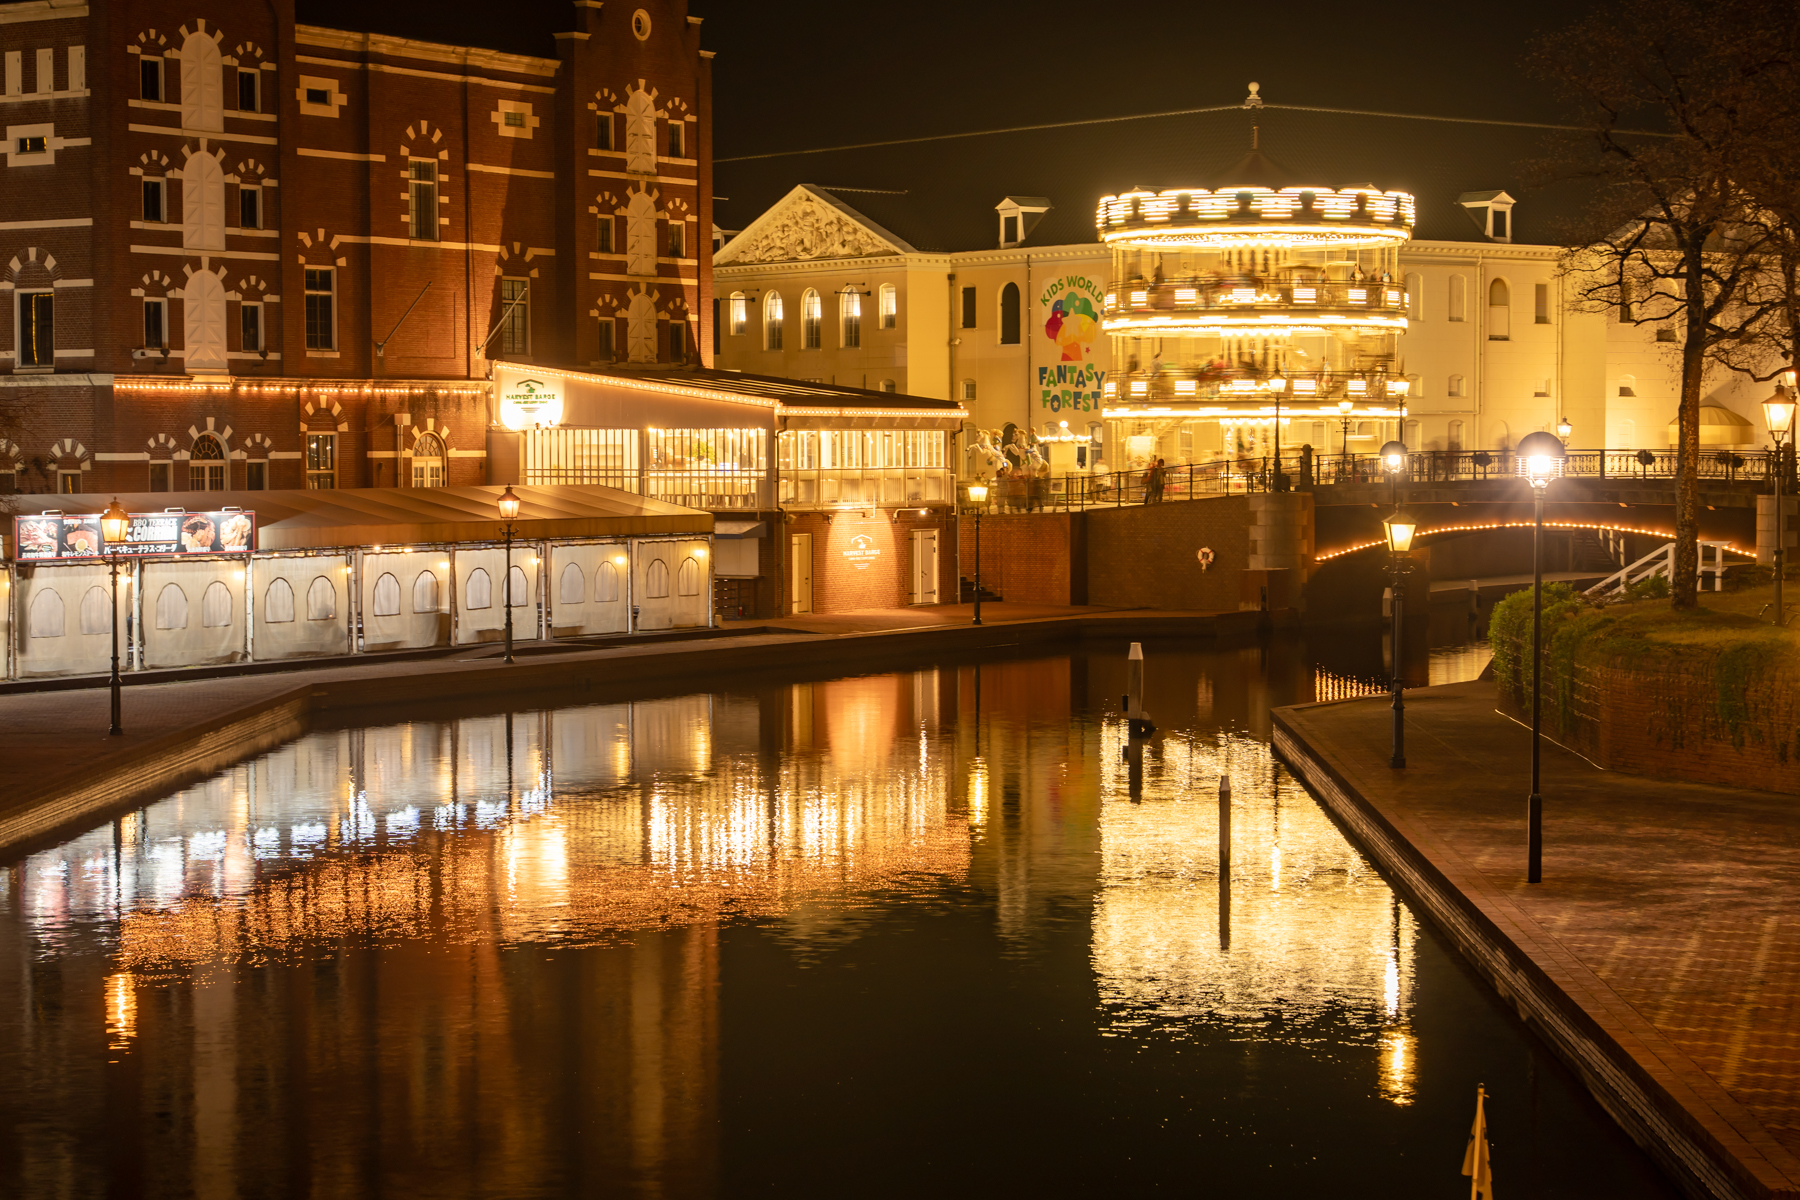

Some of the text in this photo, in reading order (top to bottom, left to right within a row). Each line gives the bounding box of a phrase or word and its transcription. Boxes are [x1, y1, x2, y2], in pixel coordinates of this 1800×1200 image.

[1040, 275, 1104, 307] KIDS WORLD
[1038, 363, 1106, 390] FANTASY
[1042, 389, 1101, 413] FOREST
[133, 519, 147, 527] BBQ
